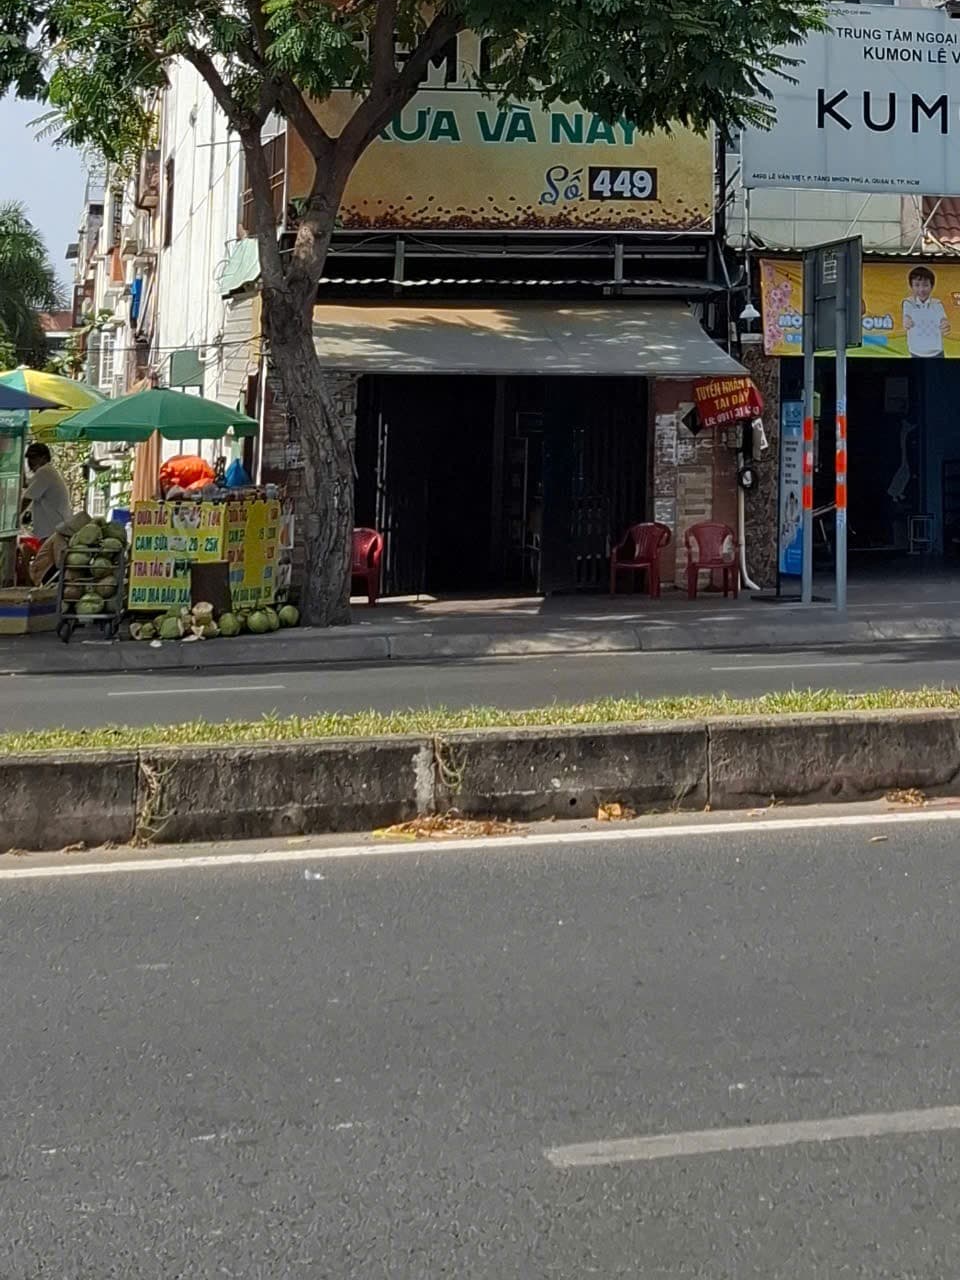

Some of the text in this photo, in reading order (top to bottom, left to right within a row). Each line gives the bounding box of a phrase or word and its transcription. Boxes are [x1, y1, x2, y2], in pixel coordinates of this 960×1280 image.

[836, 26, 881, 40] TRUNG
[886, 27, 913, 42] TÂM
[917, 31, 957, 46] NGOẠI
[864, 46, 922, 63] KUMON
[928, 47, 947, 64] LÊ
[477, 104, 537, 144] VÀ
[593, 170, 654, 198] 449
